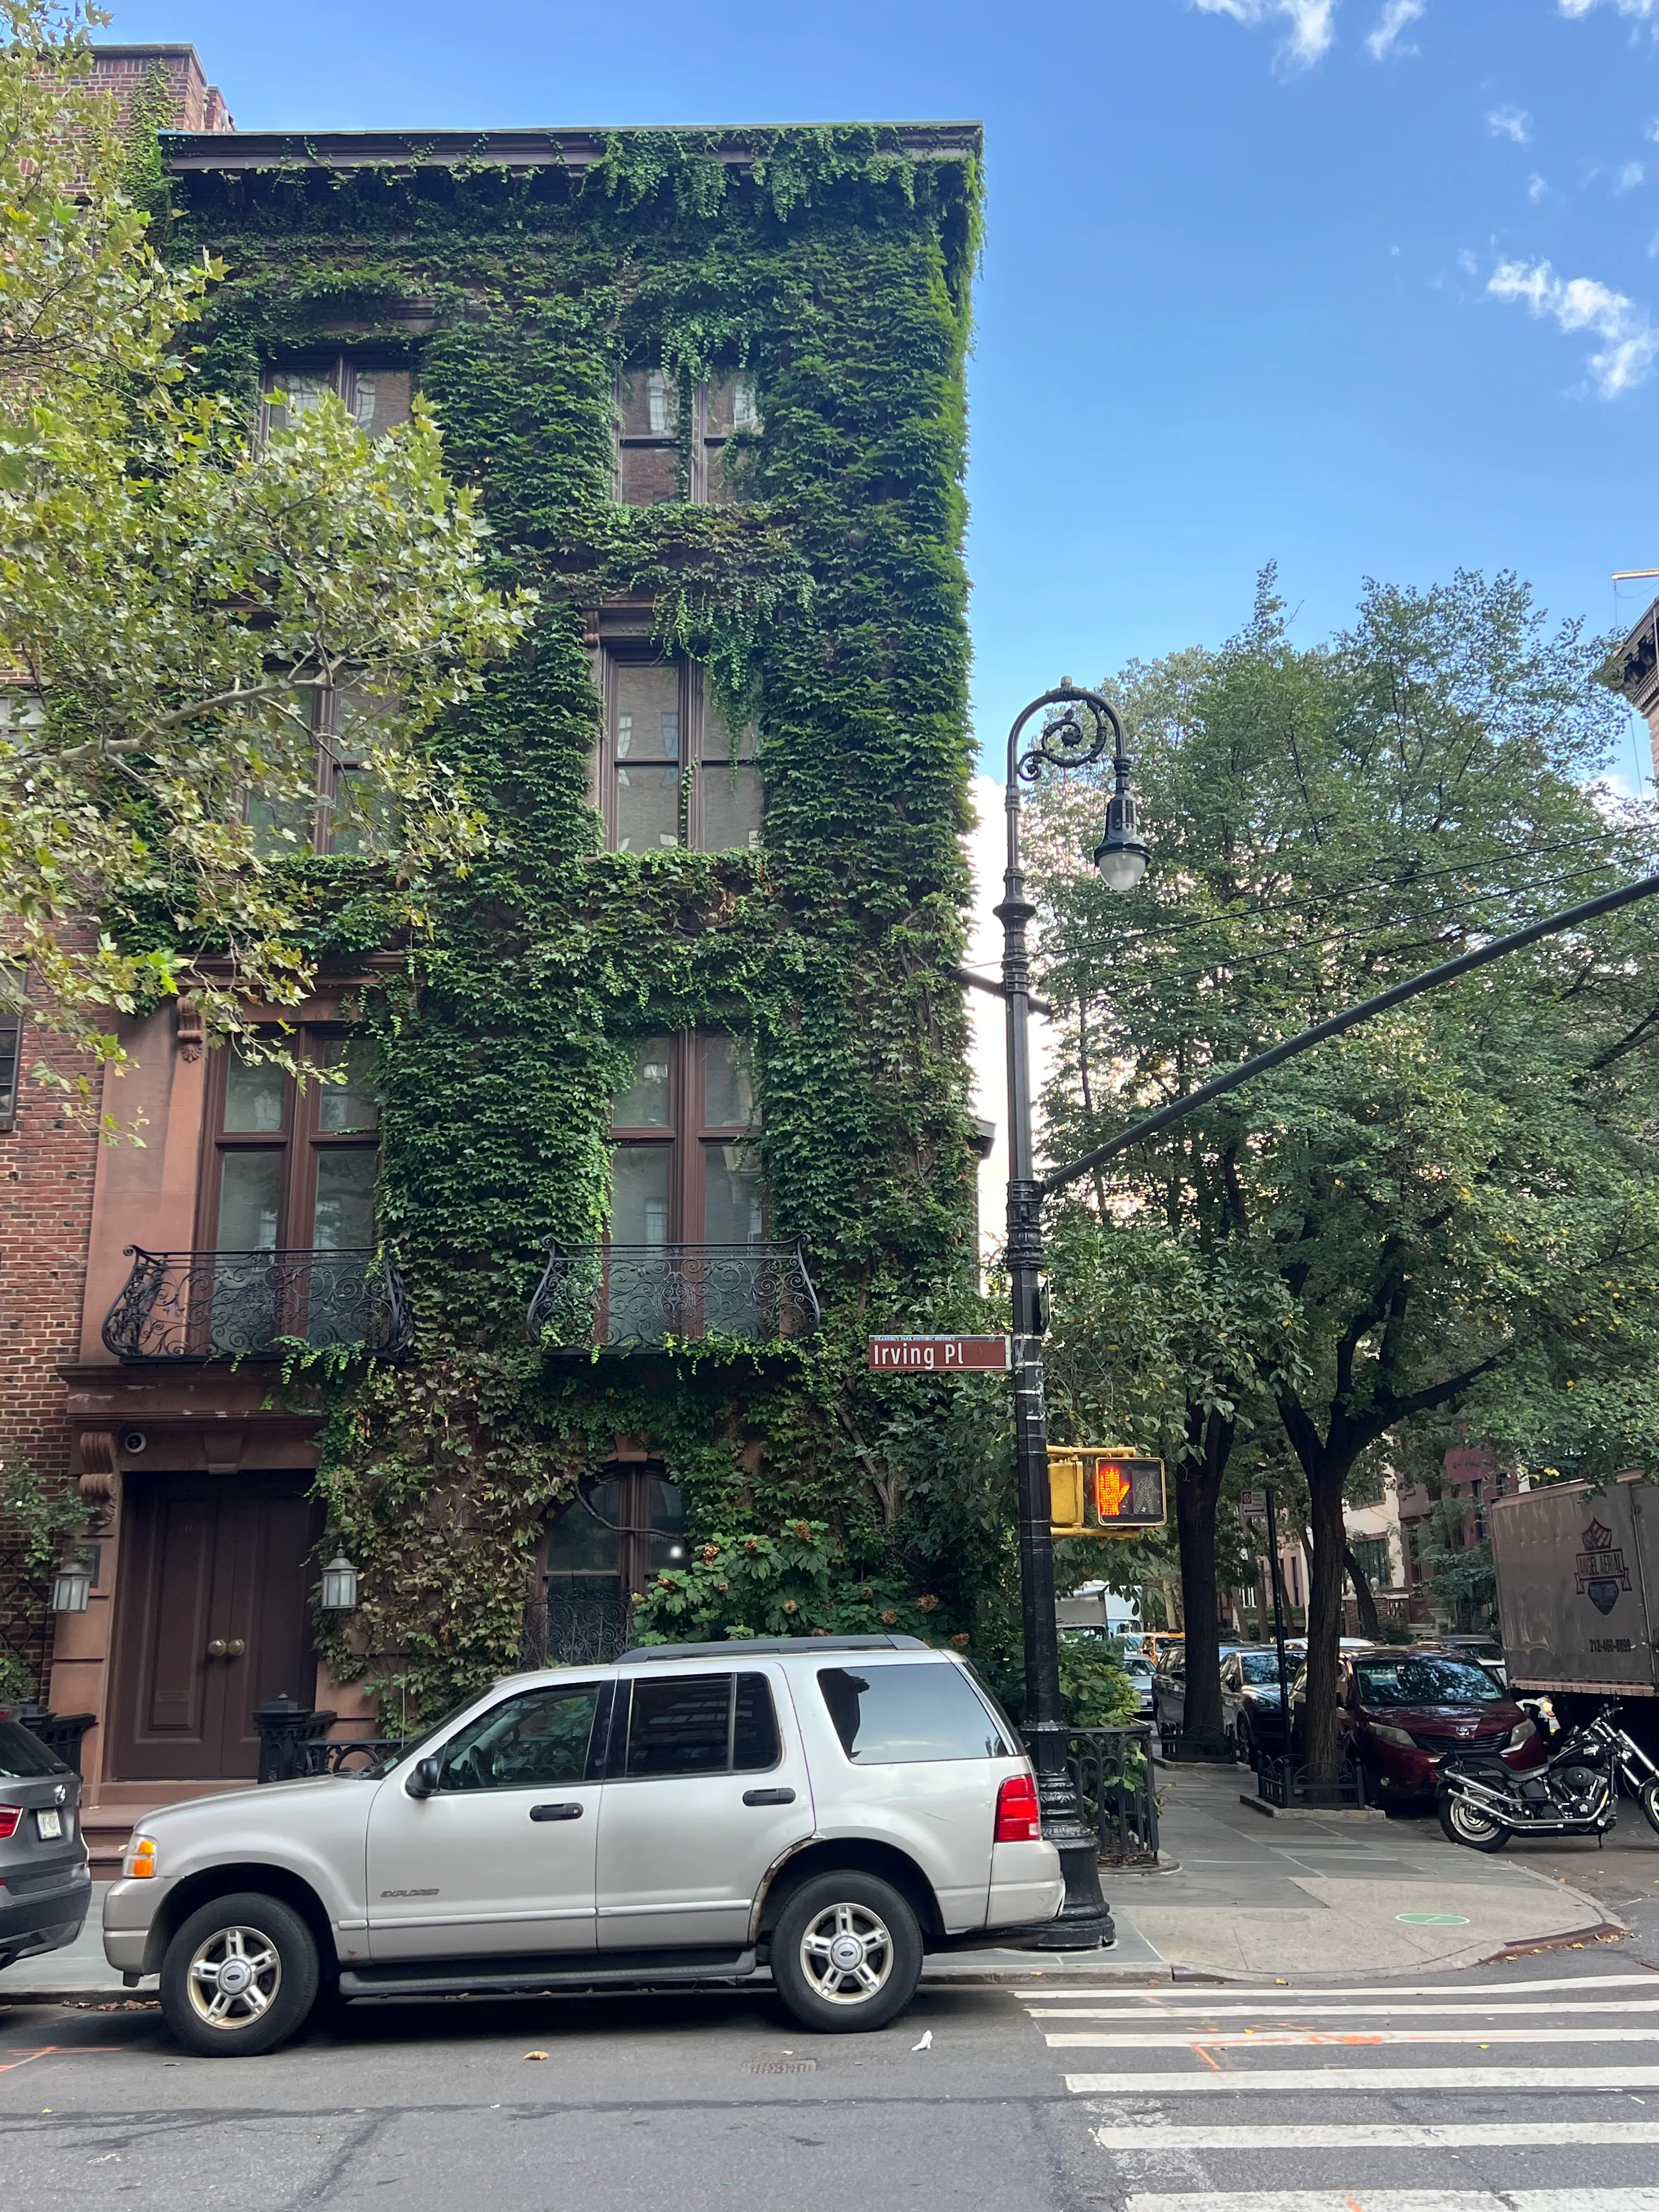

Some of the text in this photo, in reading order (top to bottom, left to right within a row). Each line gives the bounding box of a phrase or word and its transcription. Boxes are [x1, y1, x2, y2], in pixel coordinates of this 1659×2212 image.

[874, 1342, 963, 1370] Irving Pl
[1578, 1553, 1623, 1577] ANGEL AERIAL
[380, 1888, 439, 1898] EXPLORER
